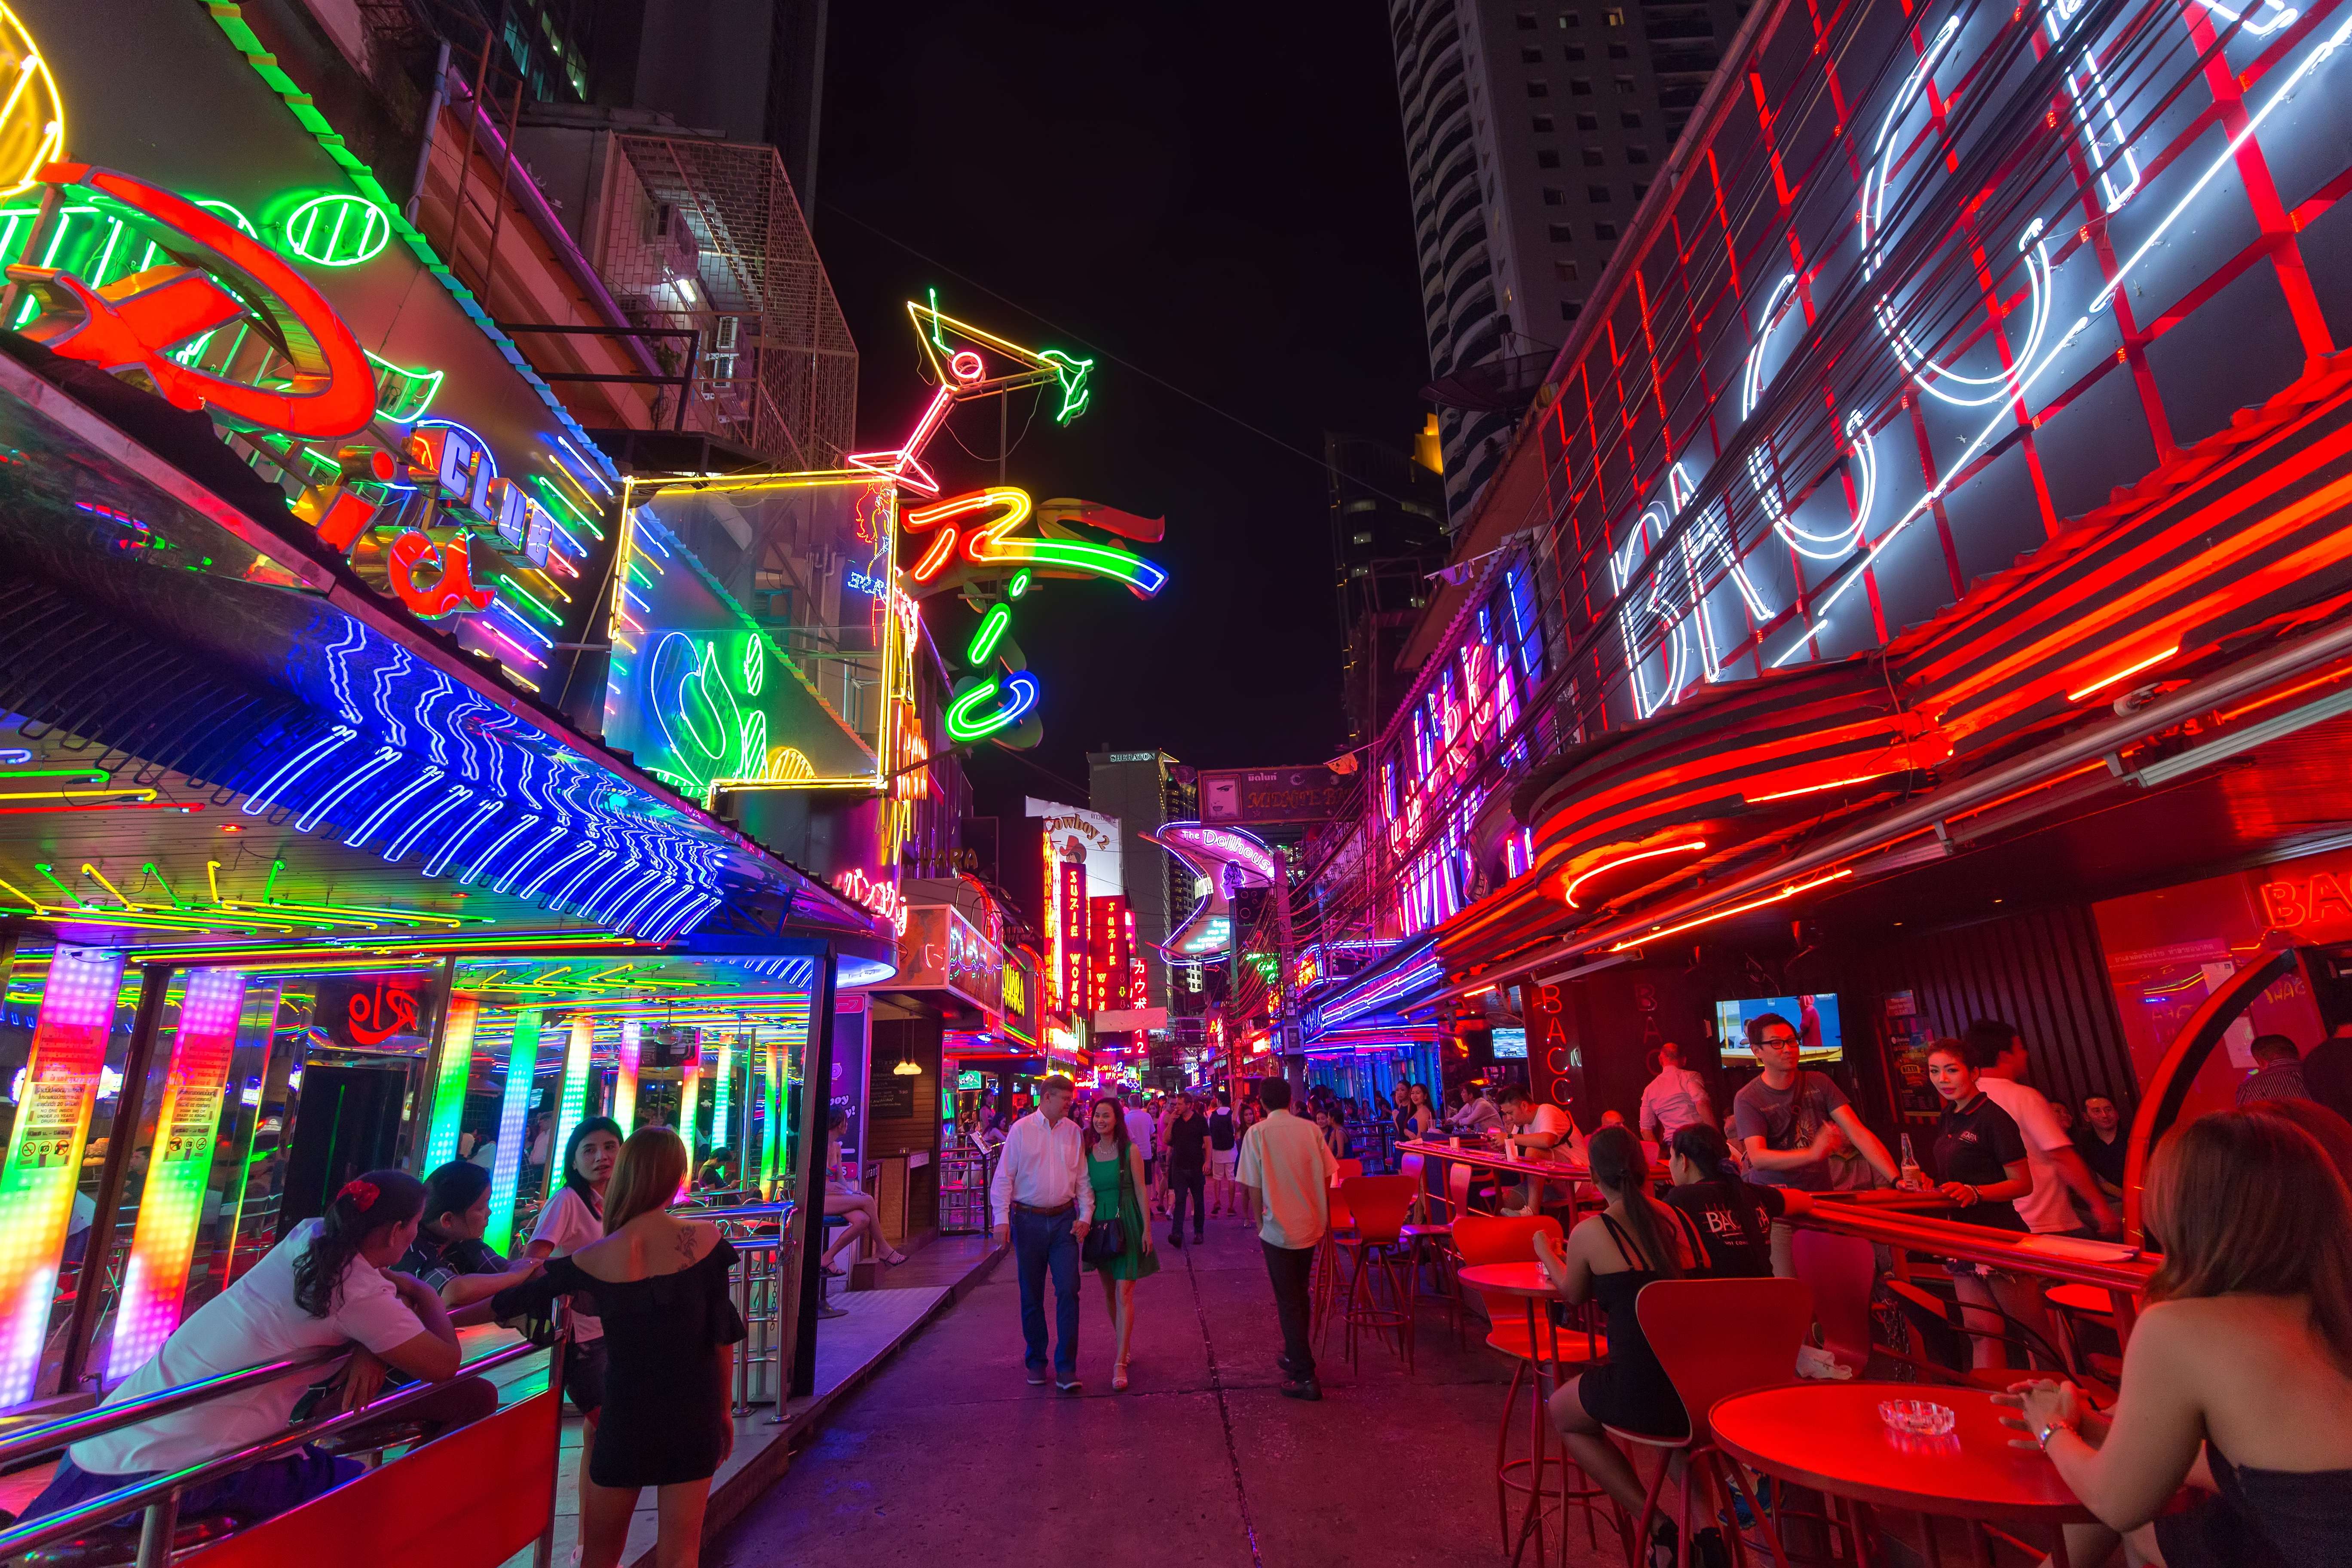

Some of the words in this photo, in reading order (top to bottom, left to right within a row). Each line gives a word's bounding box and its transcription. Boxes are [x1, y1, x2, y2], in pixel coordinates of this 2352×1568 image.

[440, 426, 554, 569] CLUB
[1110, 753, 1155, 763] SHERATON
[1043, 814, 1100, 839] Cowboy
[1097, 835, 1110, 851] 2
[1182, 830, 1200, 840] The
[1069, 871, 1079, 937] SUZIE
[1107, 902, 1116, 966] SUZIE
[1069, 953, 1081, 1006] WONG
